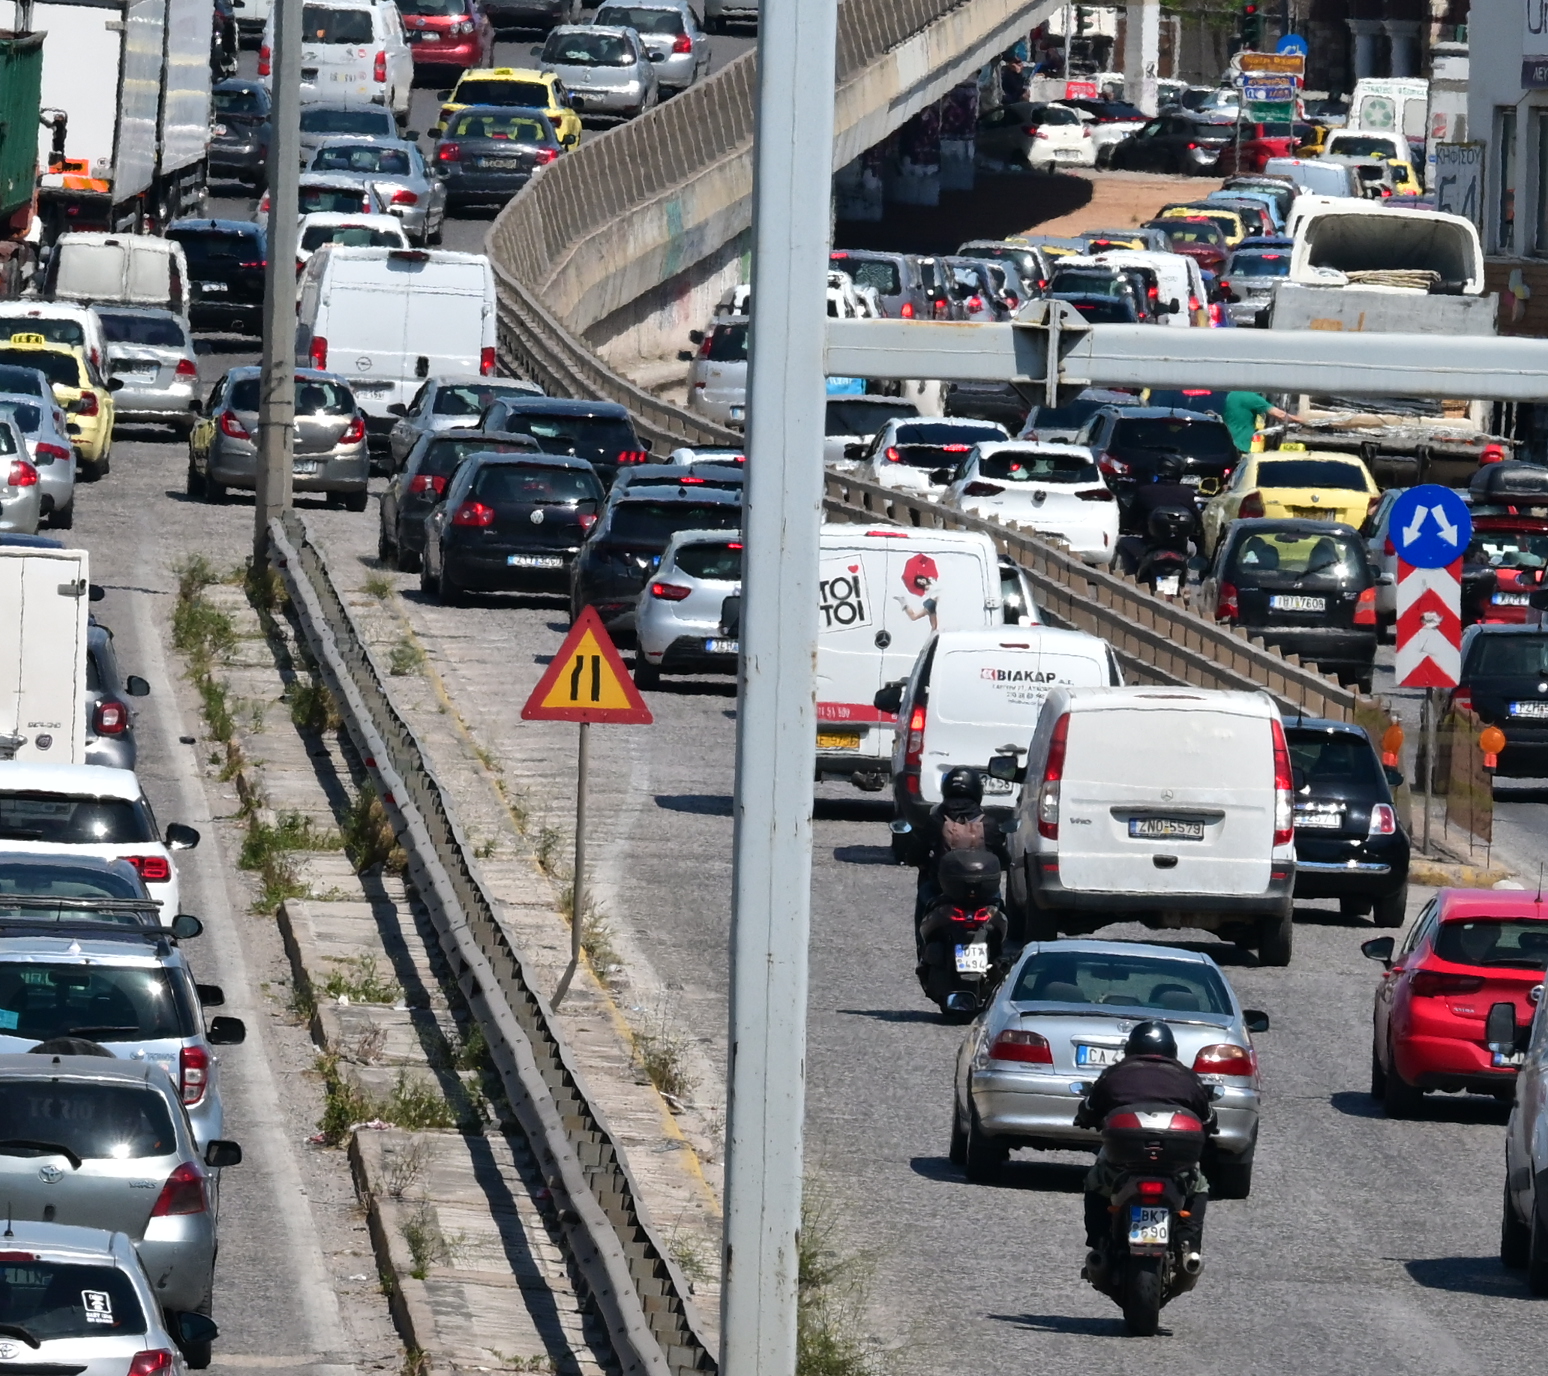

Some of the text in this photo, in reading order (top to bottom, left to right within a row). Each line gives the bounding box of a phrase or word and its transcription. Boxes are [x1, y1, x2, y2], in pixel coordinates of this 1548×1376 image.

[1436, 148, 1482, 165] ΚΗΦΙΣΟΥ
[819, 575, 861, 603] TOI
[819, 600, 865, 627] TOI
[1138, 819, 1202, 836] ZNO-5579
[1142, 1209, 1169, 1223] BKT
[1140, 1226, 1167, 1239] 690
